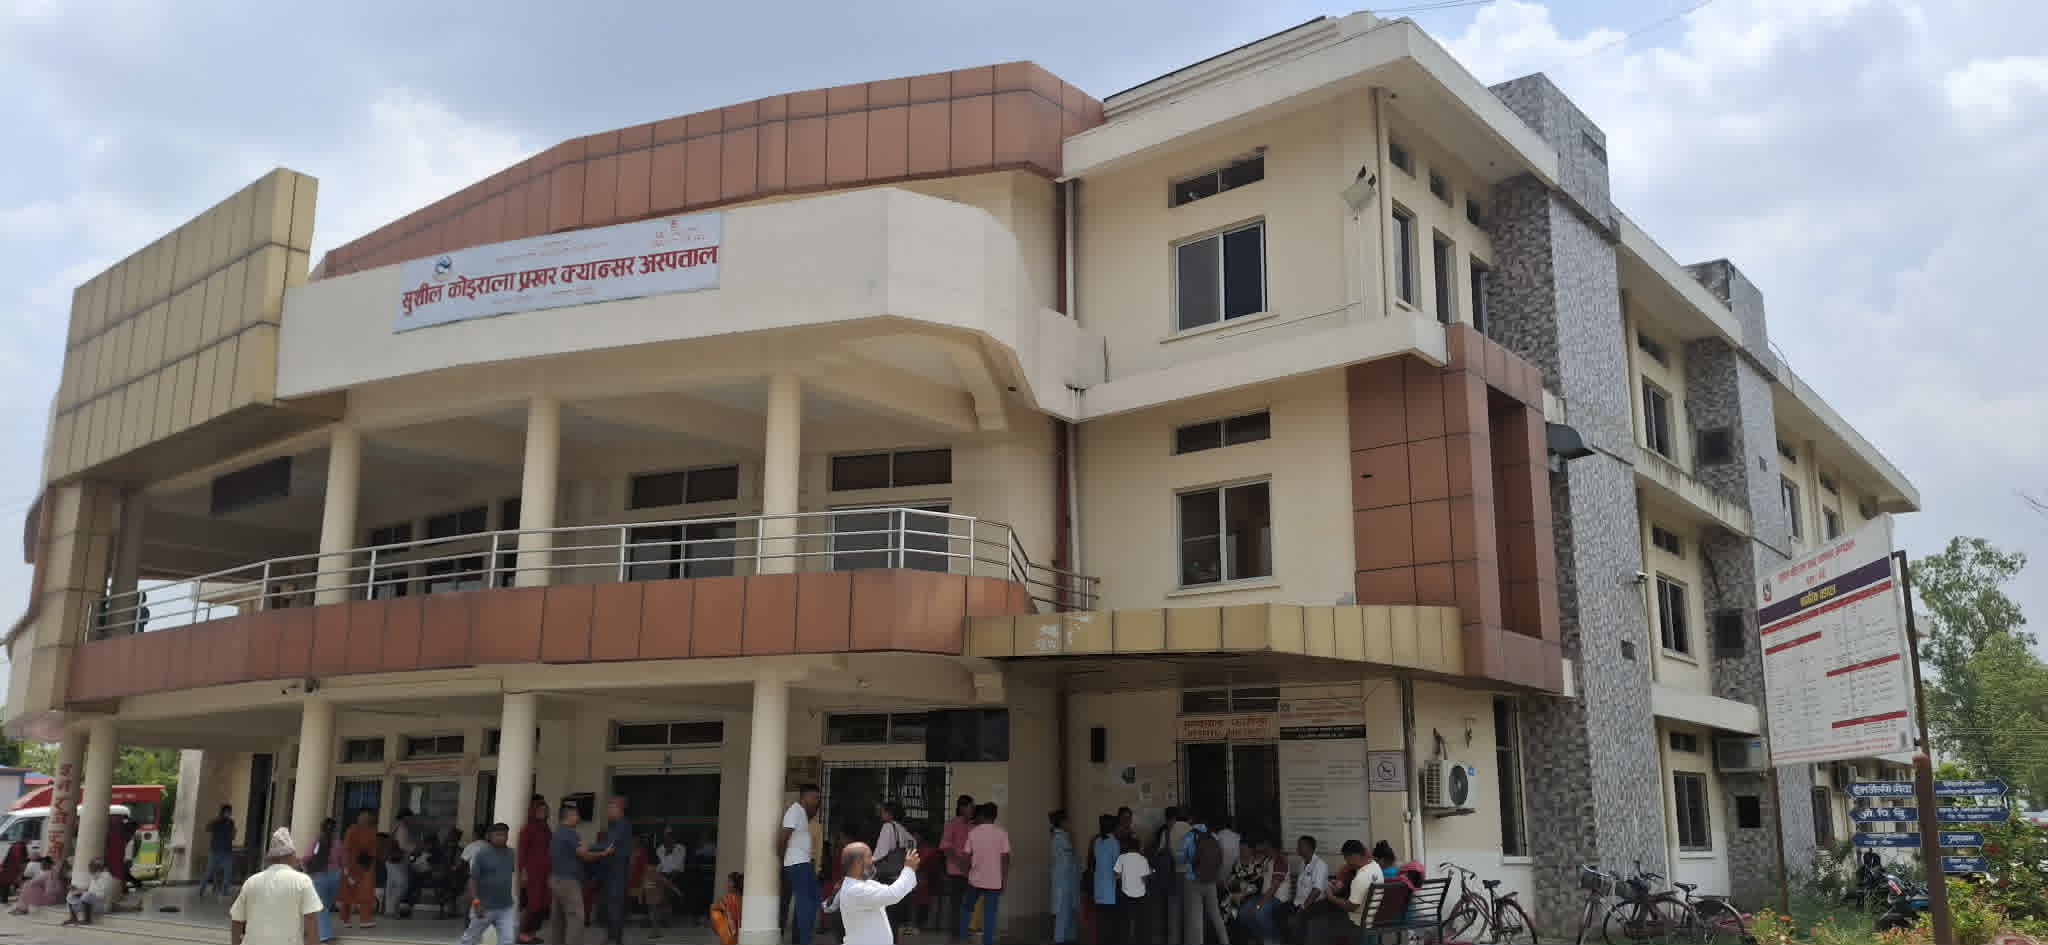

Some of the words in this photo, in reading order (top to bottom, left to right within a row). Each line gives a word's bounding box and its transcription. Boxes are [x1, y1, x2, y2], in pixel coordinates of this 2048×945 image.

[402, 283, 442, 314] सुशील
[447, 274, 516, 300] कोइराला
[518, 267, 558, 292] प्रखर
[560, 256, 636, 284] क्यान्सर
